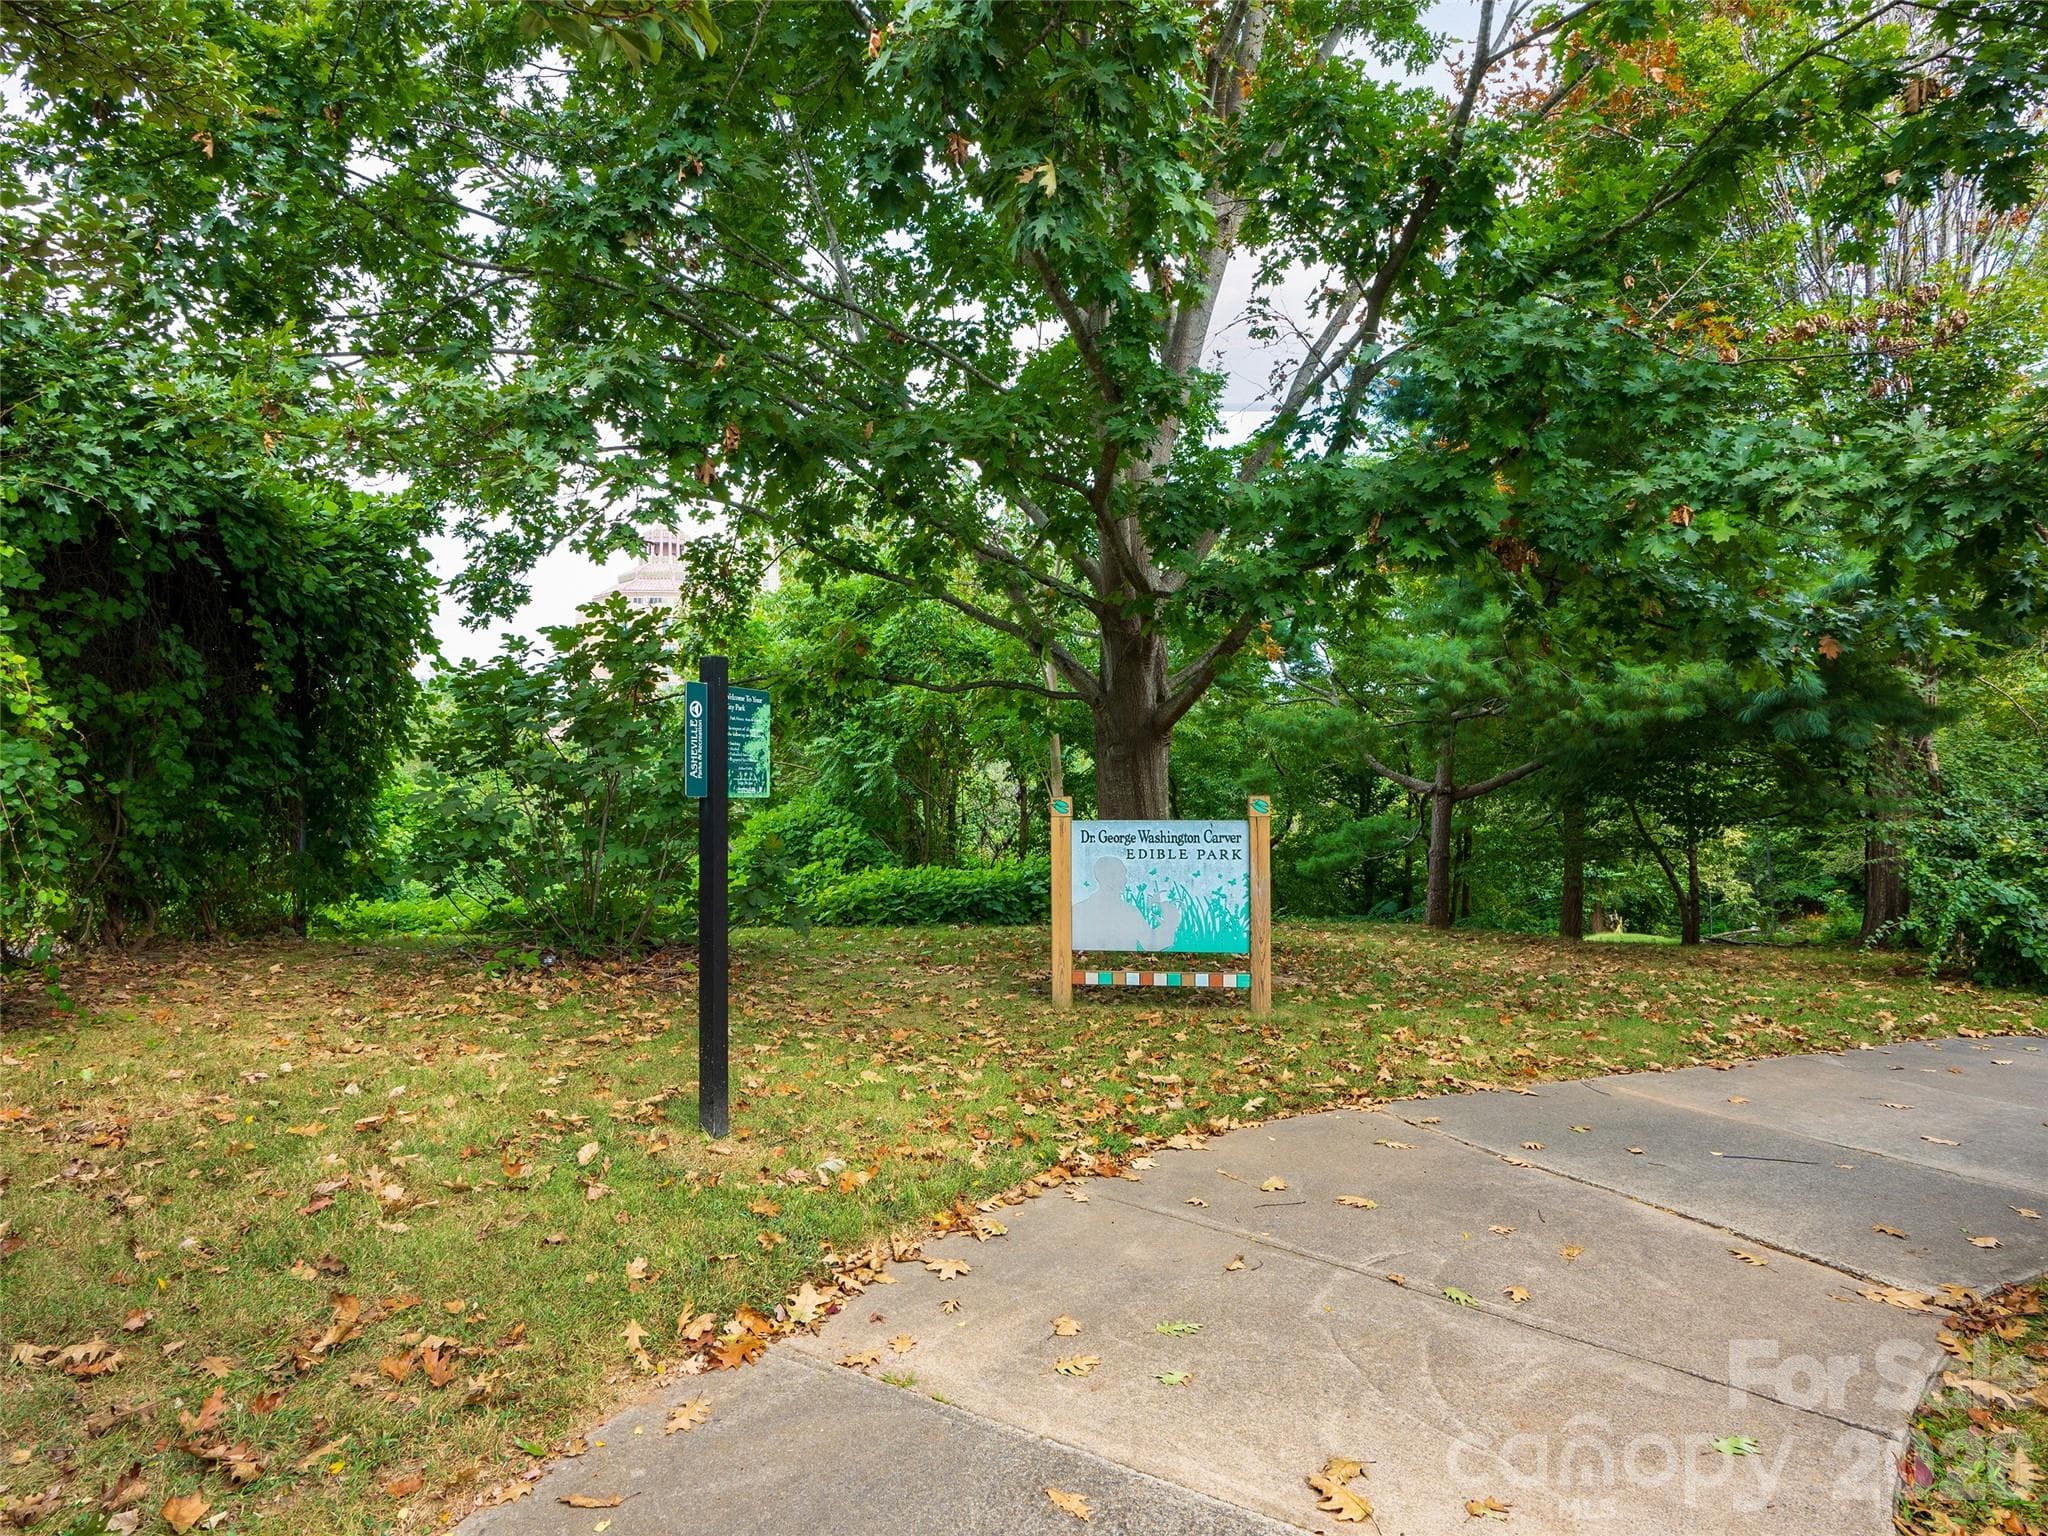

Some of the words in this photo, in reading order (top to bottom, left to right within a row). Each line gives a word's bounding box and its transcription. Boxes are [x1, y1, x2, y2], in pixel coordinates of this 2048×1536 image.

[690, 719, 698, 779] ASHEVILLE
[1081, 830, 1095, 844] Dr.
[1098, 830, 1136, 846] George
[1138, 830, 1201, 846] Washington
[1203, 829, 1242, 844] Carver
[1126, 849, 1189, 860] EDIBLE
[1197, 849, 1243, 860] PARK
